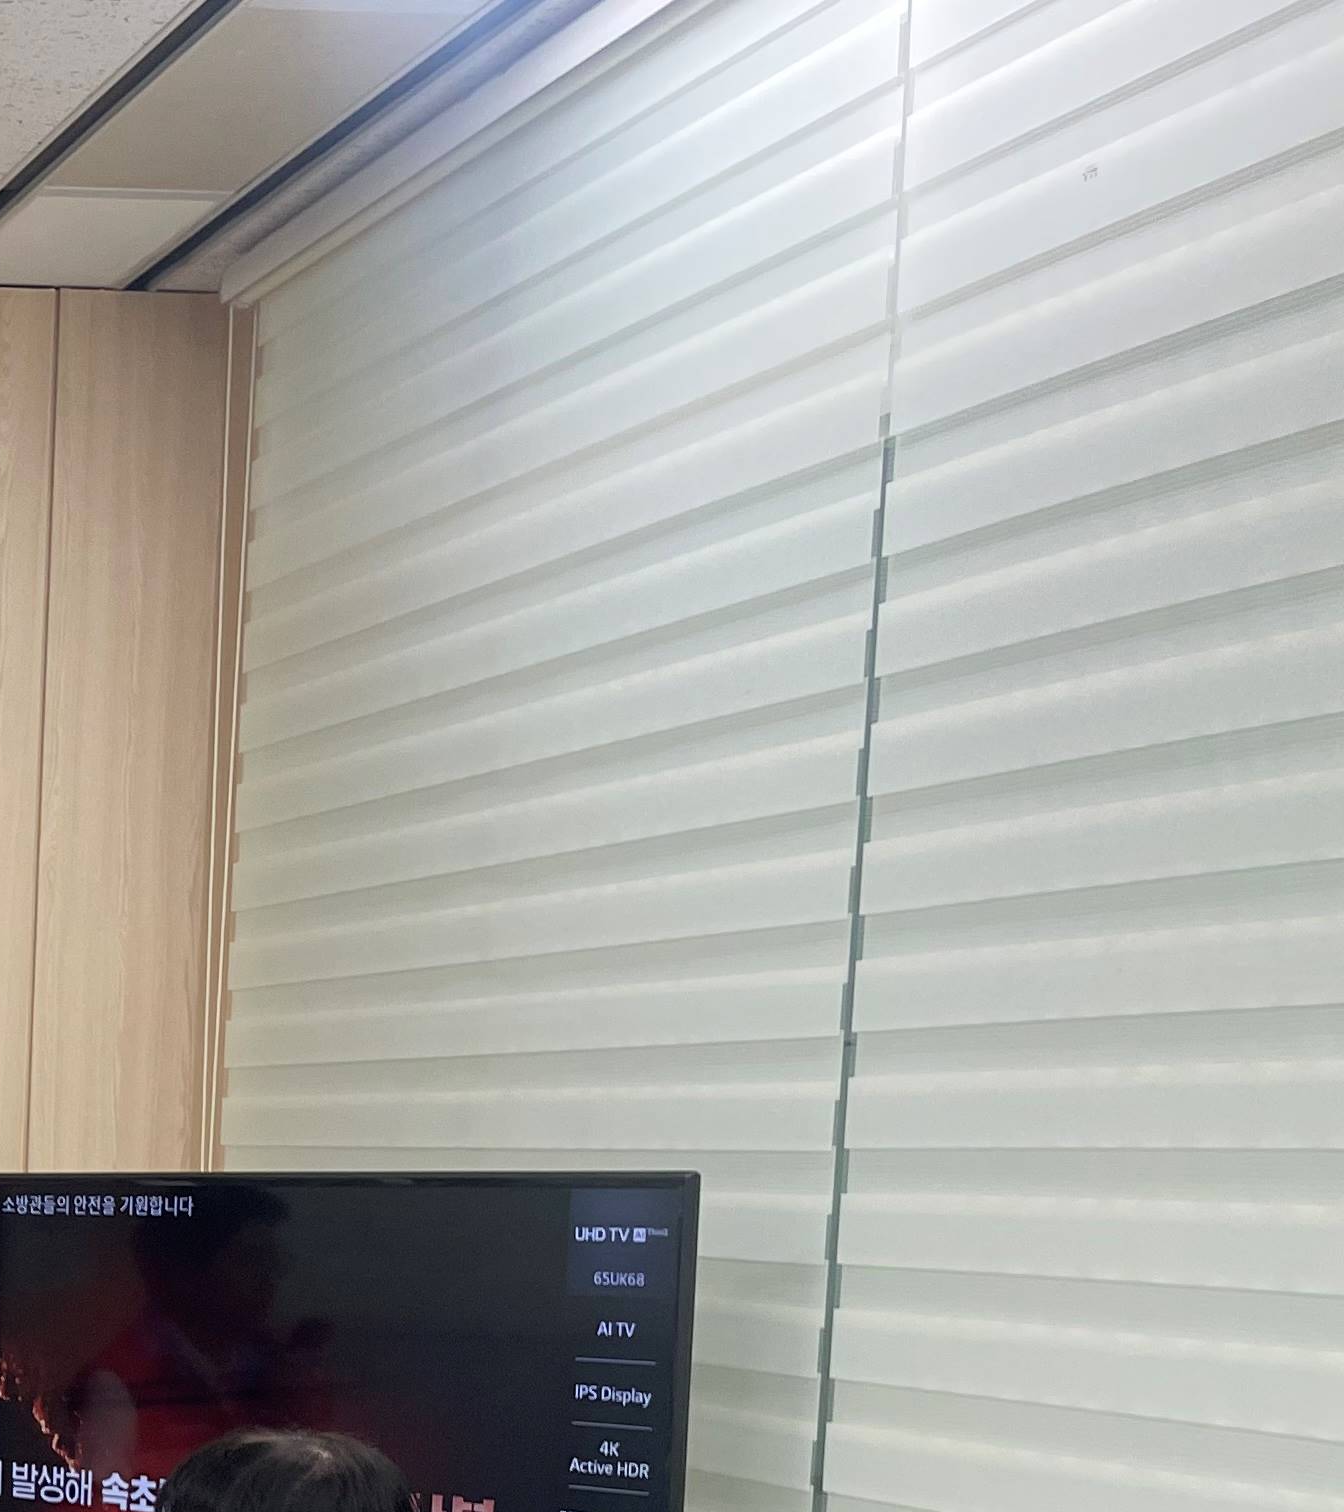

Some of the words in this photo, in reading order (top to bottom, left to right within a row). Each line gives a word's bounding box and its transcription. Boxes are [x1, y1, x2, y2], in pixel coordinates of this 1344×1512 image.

[1, 1195, 69, 1216] 소방관들의
[73, 1196, 115, 1217] 안전을
[119, 1196, 194, 1217] 기원합니다
[575, 1226, 607, 1242] UHD
[609, 1227, 630, 1243] TV
[593, 1271, 646, 1288] 65UK68
[615, 1322, 636, 1339] TV
[575, 1384, 598, 1402] IPS
[601, 1386, 653, 1408] Display
[600, 1441, 620, 1457] 4K
[569, 1458, 613, 1477] Active
[617, 1462, 649, 1480] HDR
[12, 1461, 93, 1507] 발생해
